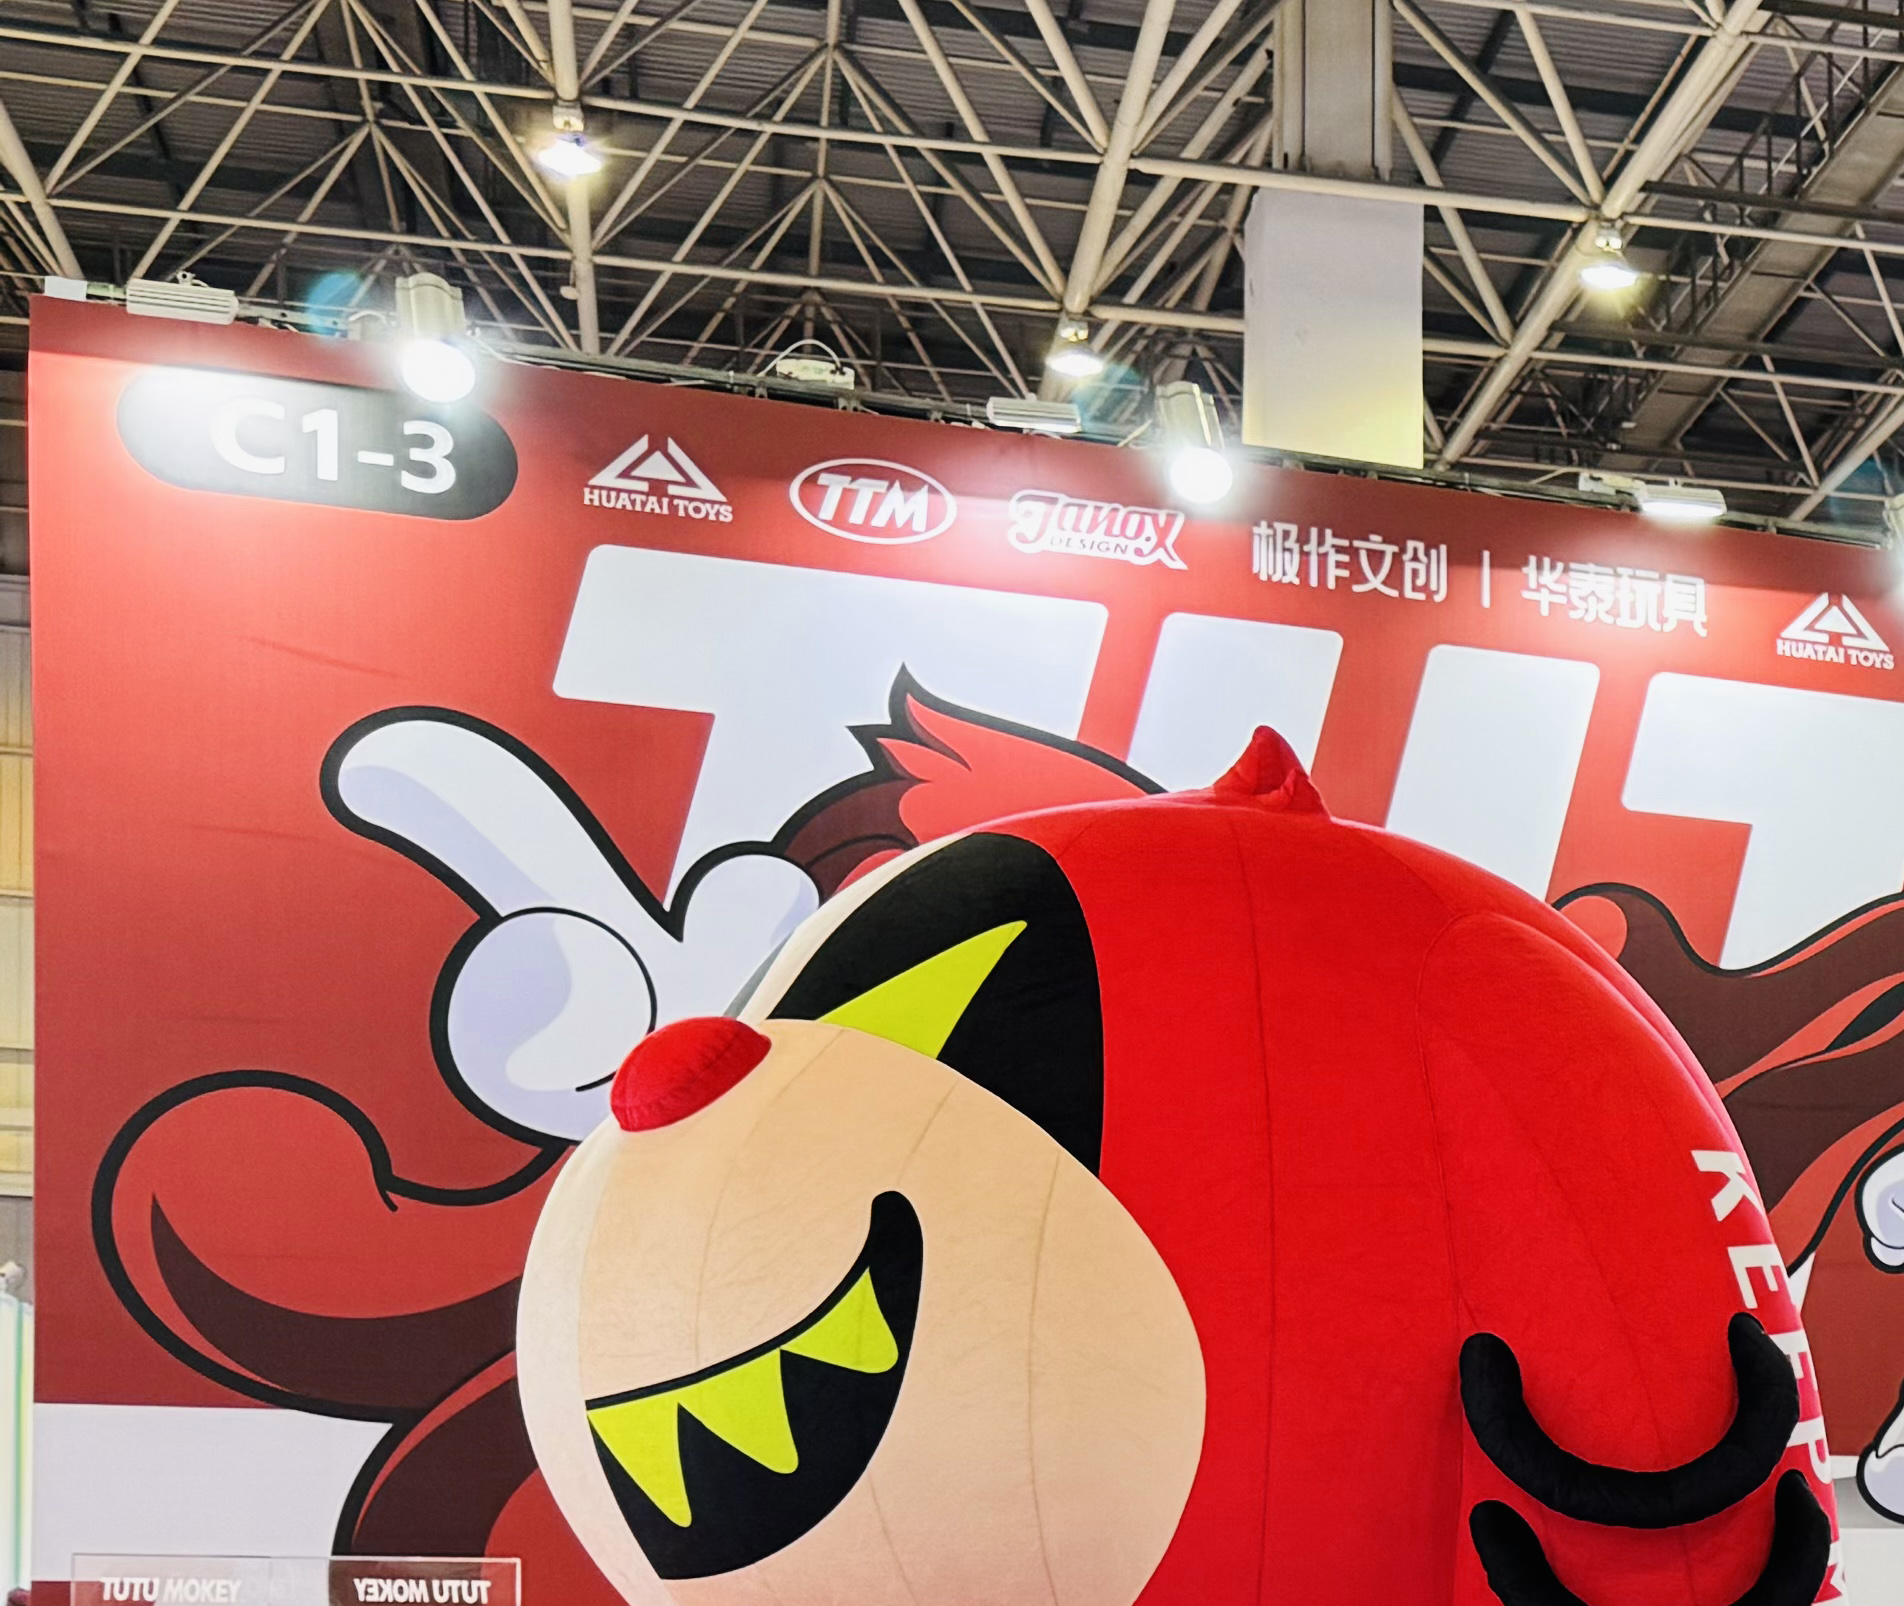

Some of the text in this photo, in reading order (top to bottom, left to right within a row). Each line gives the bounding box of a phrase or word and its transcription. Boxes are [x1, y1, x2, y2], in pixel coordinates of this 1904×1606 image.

[209, 396, 456, 495] C1-3
[584, 487, 734, 523] HUATAI TOYS
[814, 473, 931, 532] TTM
[1050, 536, 1128, 555] DESIGN
[1252, 521, 1708, 637] 极作文创 华泰玩具
[1776, 638, 1895, 670] HUATAI TOYS
[102, 1577, 241, 1603] TUTU MOKEY
